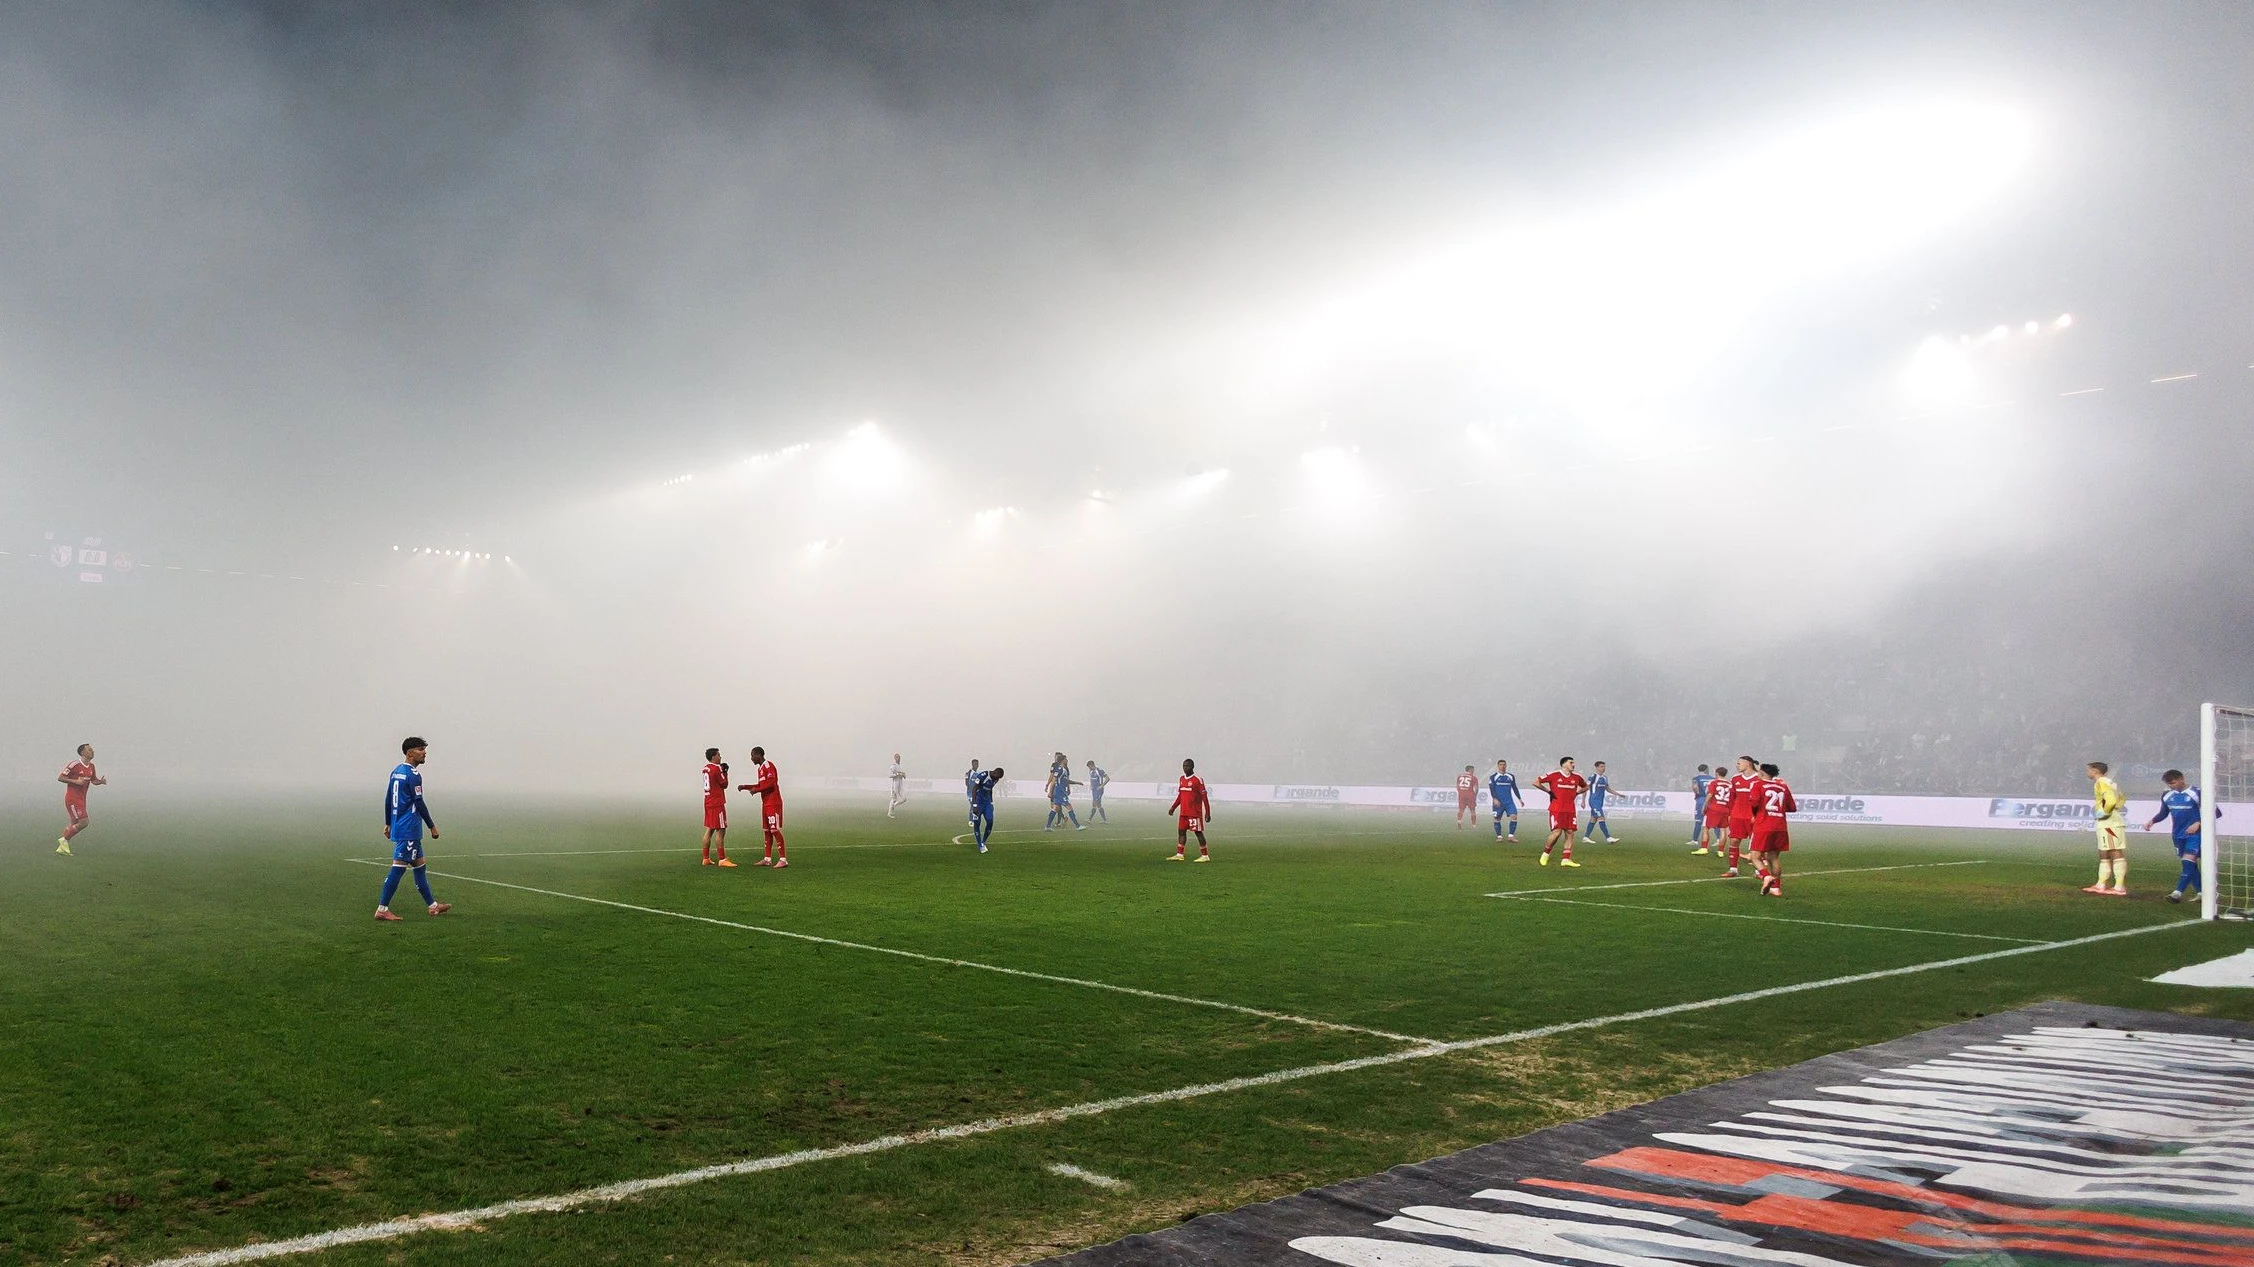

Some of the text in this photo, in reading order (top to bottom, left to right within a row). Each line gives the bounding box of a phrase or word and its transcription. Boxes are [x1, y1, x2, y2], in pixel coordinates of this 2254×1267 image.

[1459, 777, 1472, 787] 25
[393, 780, 399, 807] 8
[1715, 786, 1730, 802] 32
[1765, 789, 1785, 811] 21
[1795, 796, 1865, 811] gande
[1188, 818, 1197, 826] 23
[1840, 814, 1883, 823] solutions
[2019, 820, 2064, 829] creating
[411, 849, 417, 860] 8
